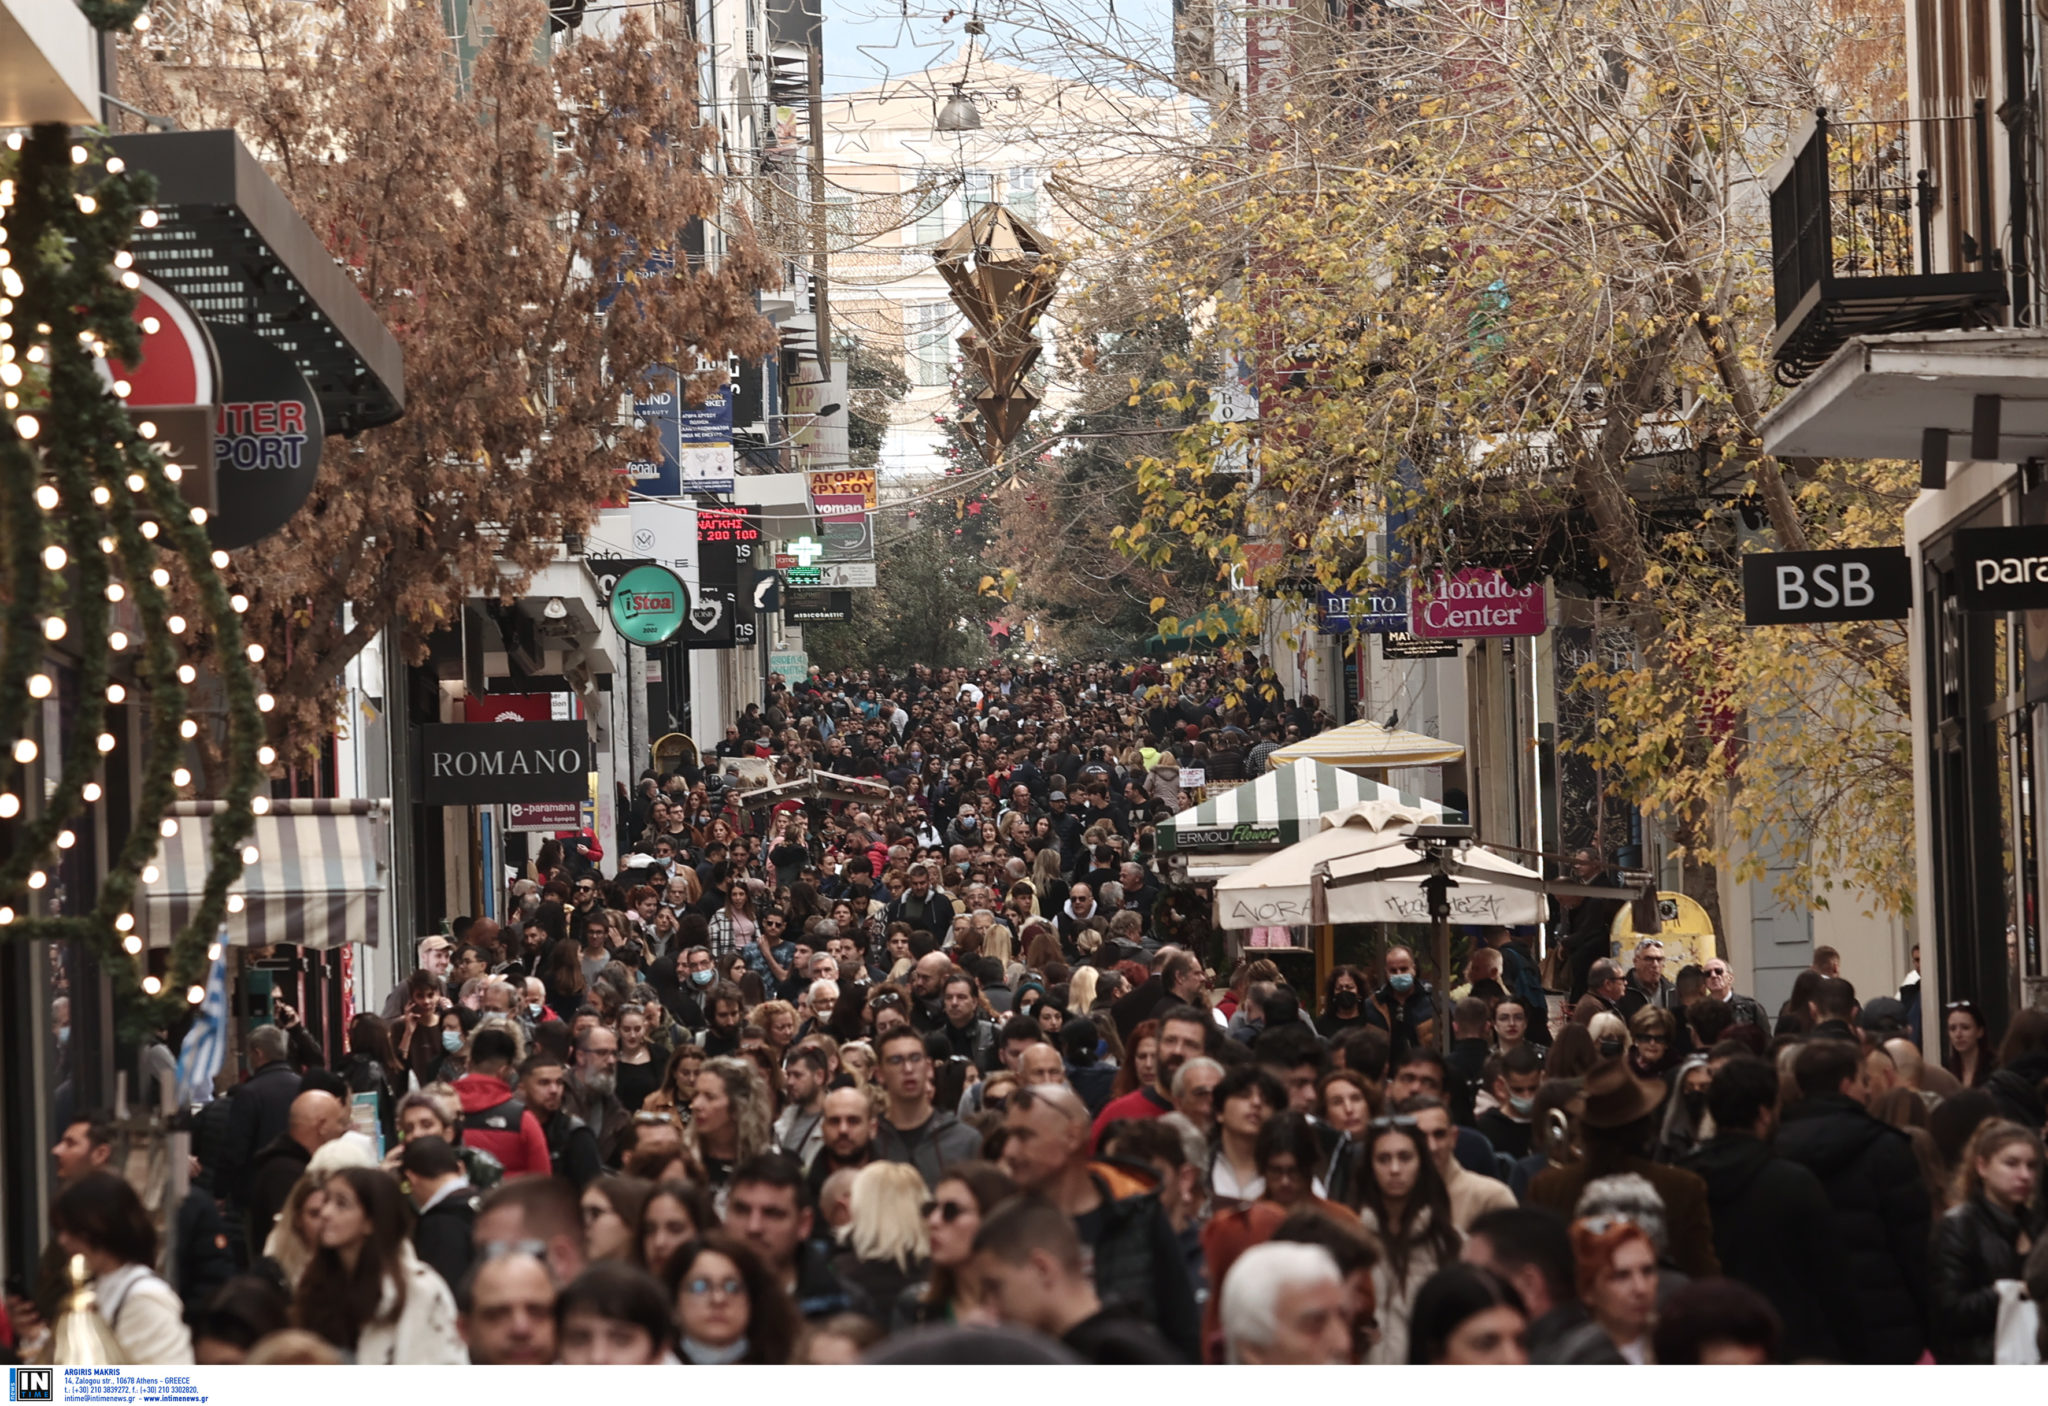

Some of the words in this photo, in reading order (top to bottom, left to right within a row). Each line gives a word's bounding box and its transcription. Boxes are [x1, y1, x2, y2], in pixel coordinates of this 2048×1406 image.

[813, 471, 867, 484] ΑΓΟΡΑ
[707, 530, 731, 541] 200
[735, 529, 758, 540] 100
[1777, 562, 1874, 611] BSB
[626, 595, 671, 610] iStoa
[1424, 600, 1522, 629] Center
[432, 749, 581, 777] ROMANO
[1177, 832, 1230, 844] ERMOU
[1232, 825, 1277, 841] Flower
